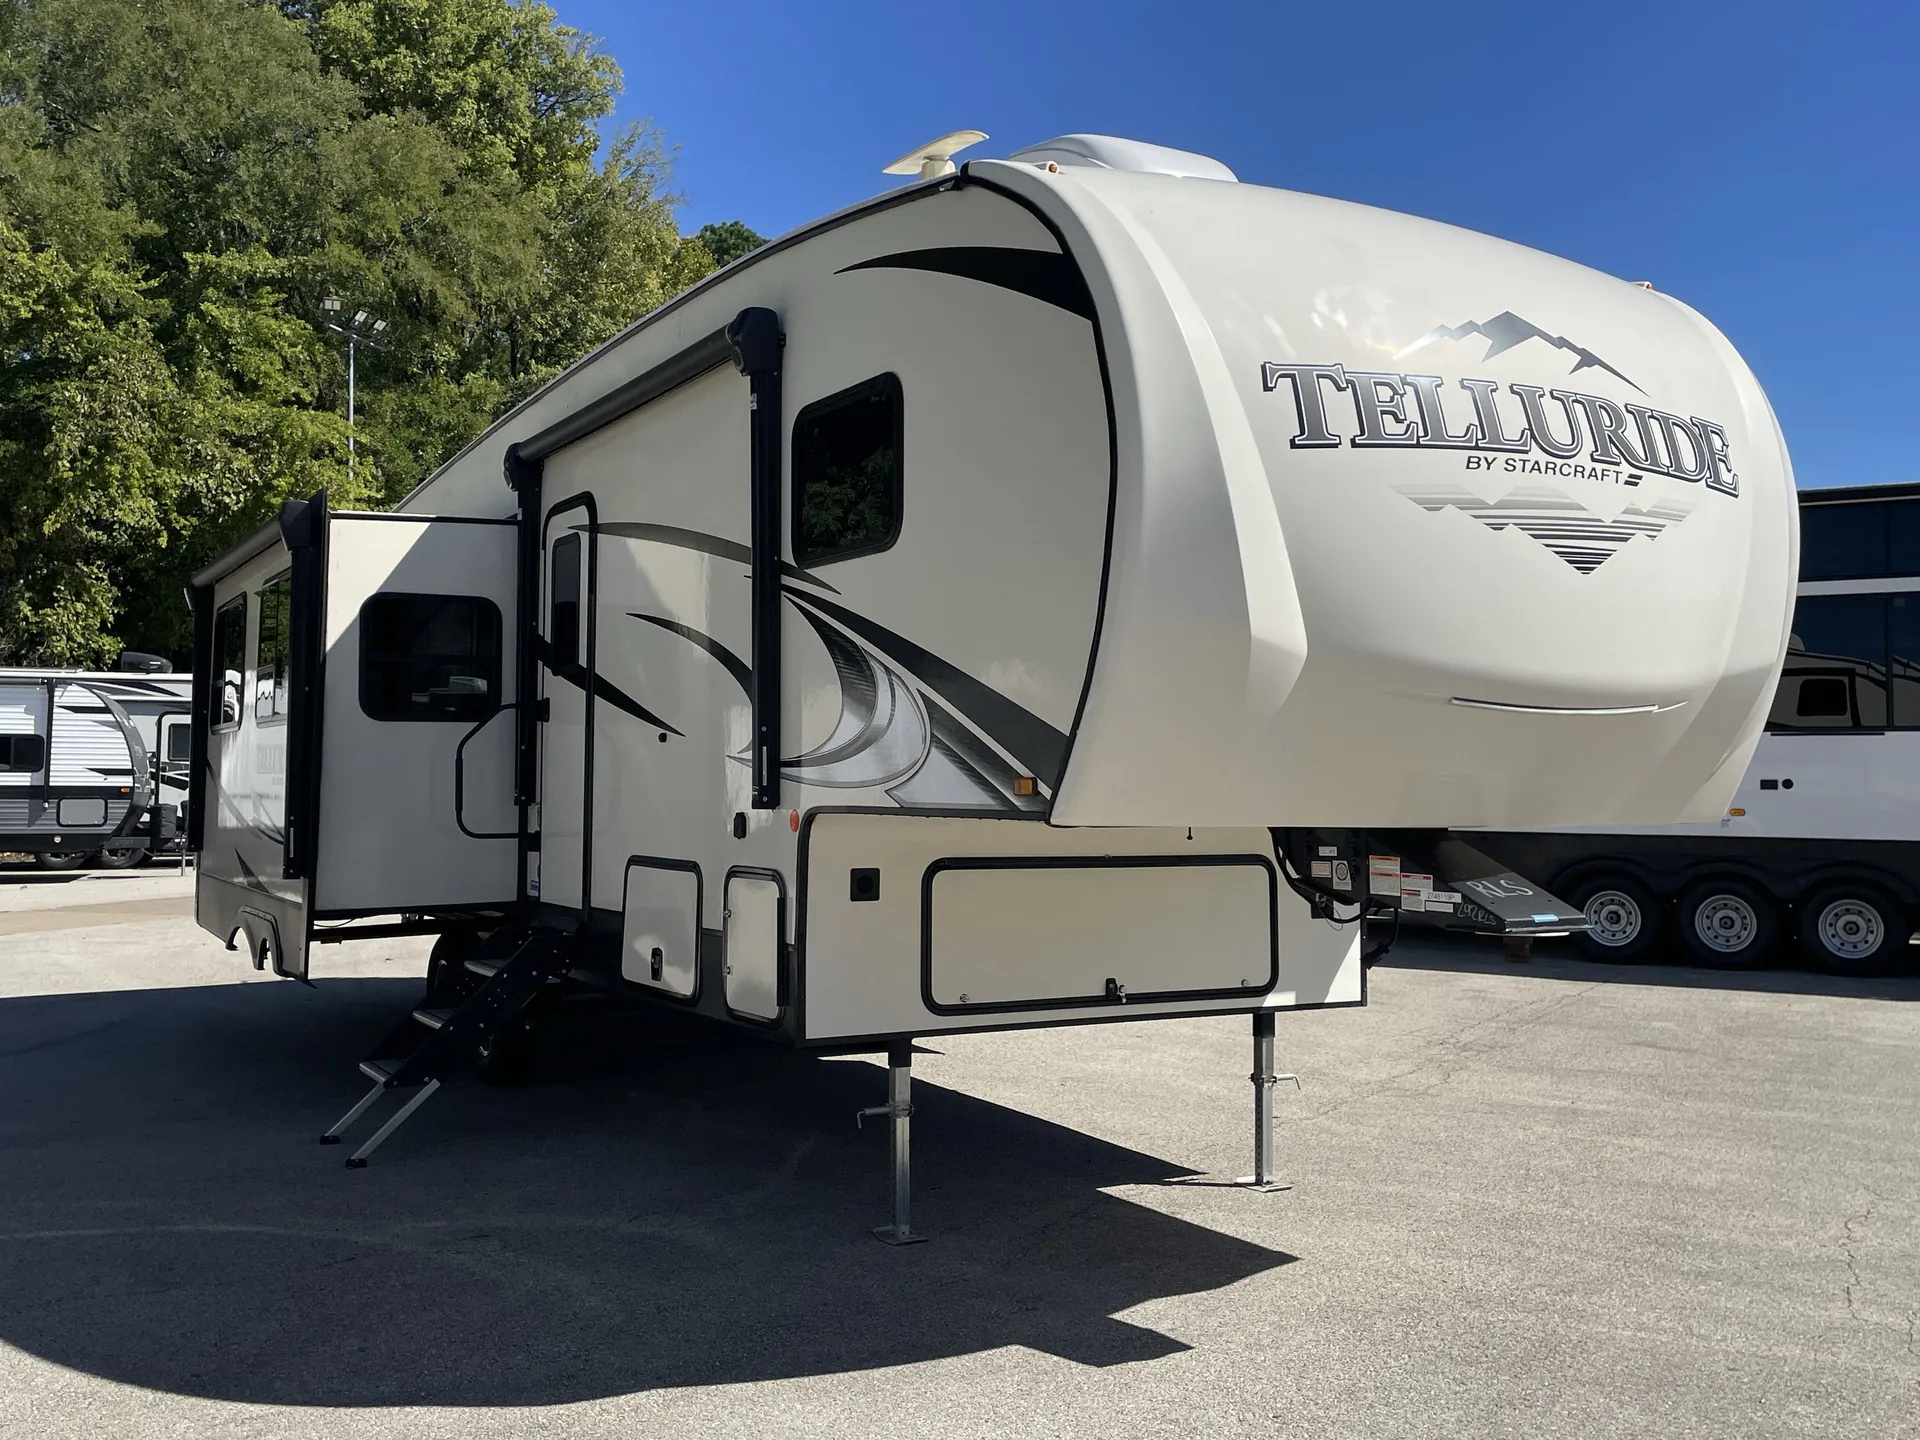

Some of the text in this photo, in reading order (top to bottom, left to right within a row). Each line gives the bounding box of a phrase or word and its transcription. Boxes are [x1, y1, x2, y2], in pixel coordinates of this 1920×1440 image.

[1261, 362, 1740, 498] TELLURIDE
[1465, 455, 1624, 484] BY STARCRAFT
[1465, 879, 1534, 899] RLS
